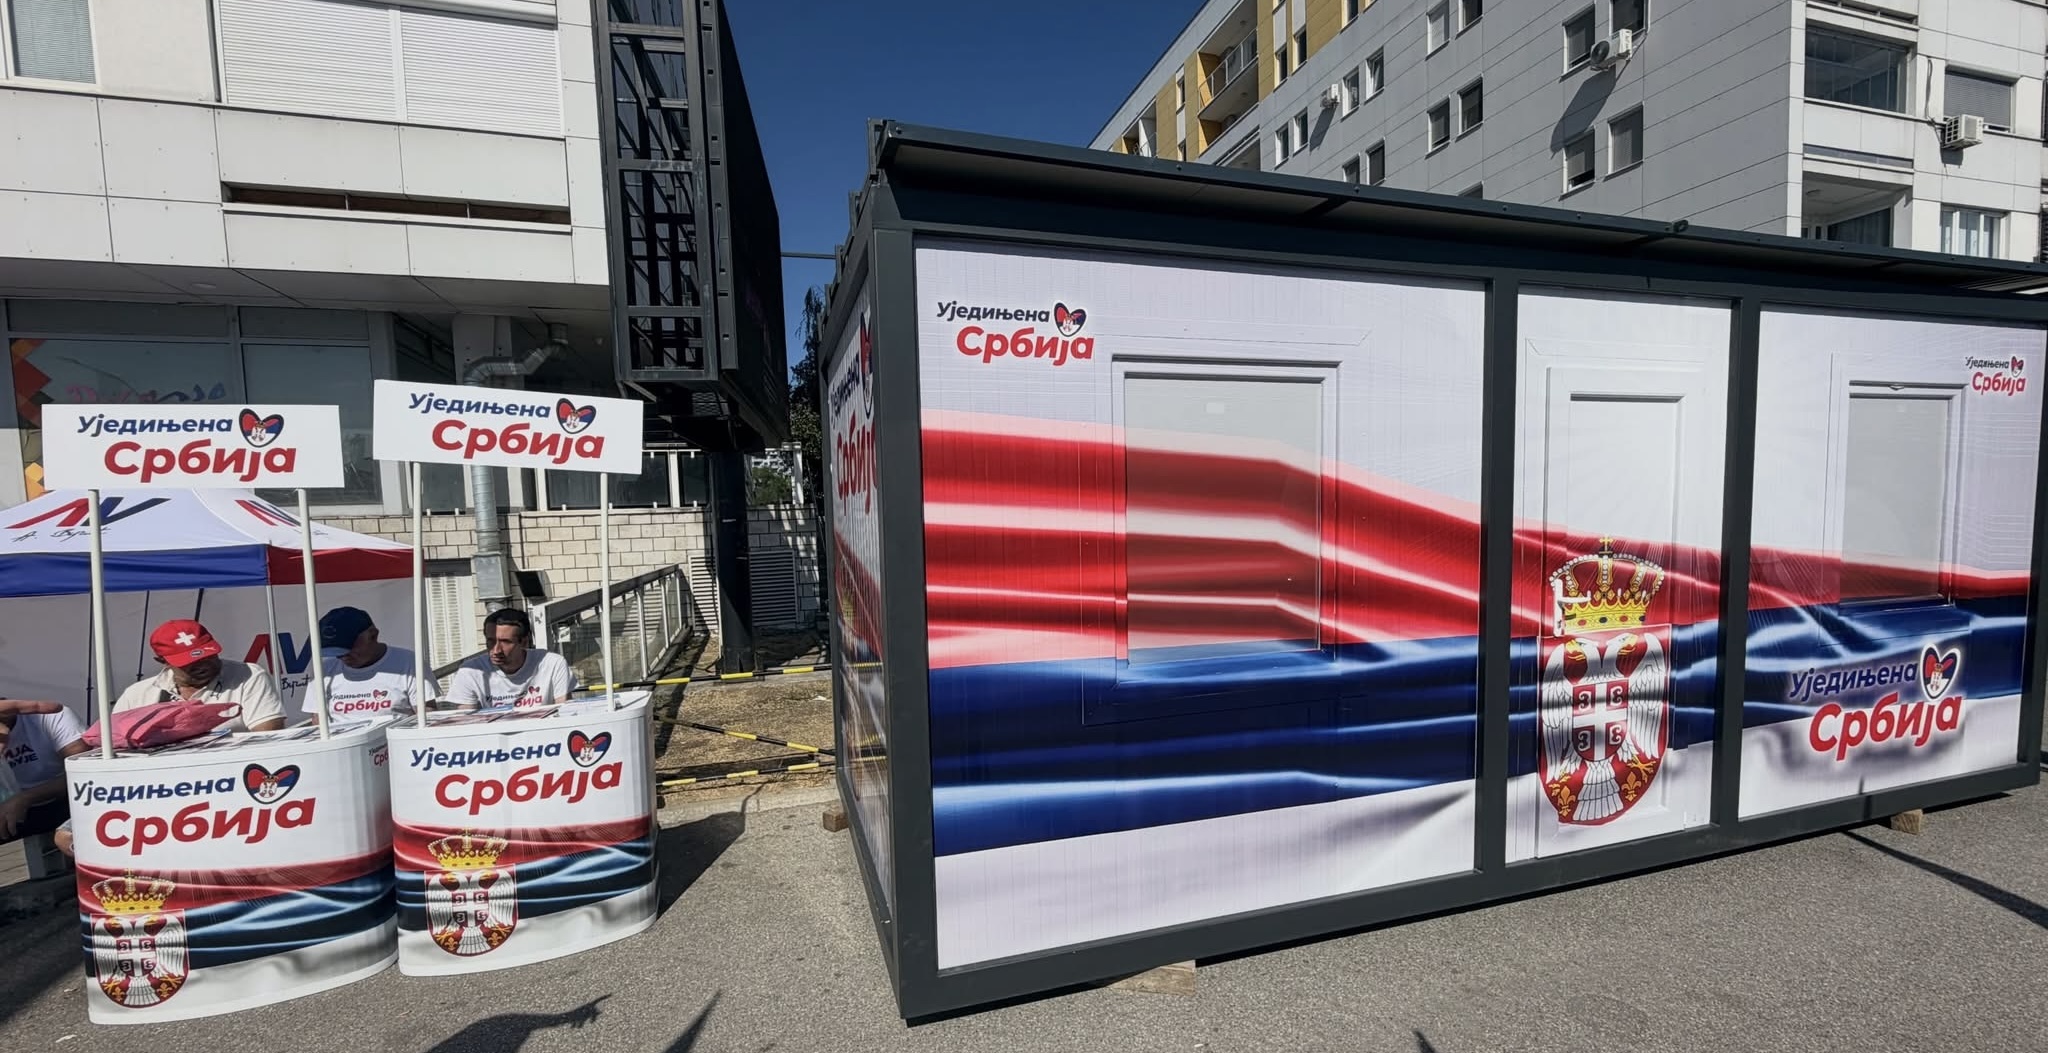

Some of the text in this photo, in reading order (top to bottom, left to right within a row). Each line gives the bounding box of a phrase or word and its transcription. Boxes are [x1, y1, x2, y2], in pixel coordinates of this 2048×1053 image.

[937, 301, 1050, 322] Уједињена
[956, 325, 1094, 367] Србија
[1965, 356, 2010, 370] Уједињена
[1972, 371, 2026, 396] Србија
[408, 392, 551, 418] Уједињена
[77, 413, 233, 437] Уједињена
[432, 419, 605, 465] Србија
[104, 439, 296, 483] Србија
[1789, 662, 1919, 702] Уједињена
[333, 700, 391, 714] Србија
[493, 695, 543, 708] бија
[1809, 692, 1963, 761] Србија
[411, 741, 562, 771] Уједињена
[73, 776, 236, 806] Уједињена
[435, 761, 623, 815] Србија
[96, 797, 317, 855] Србија
